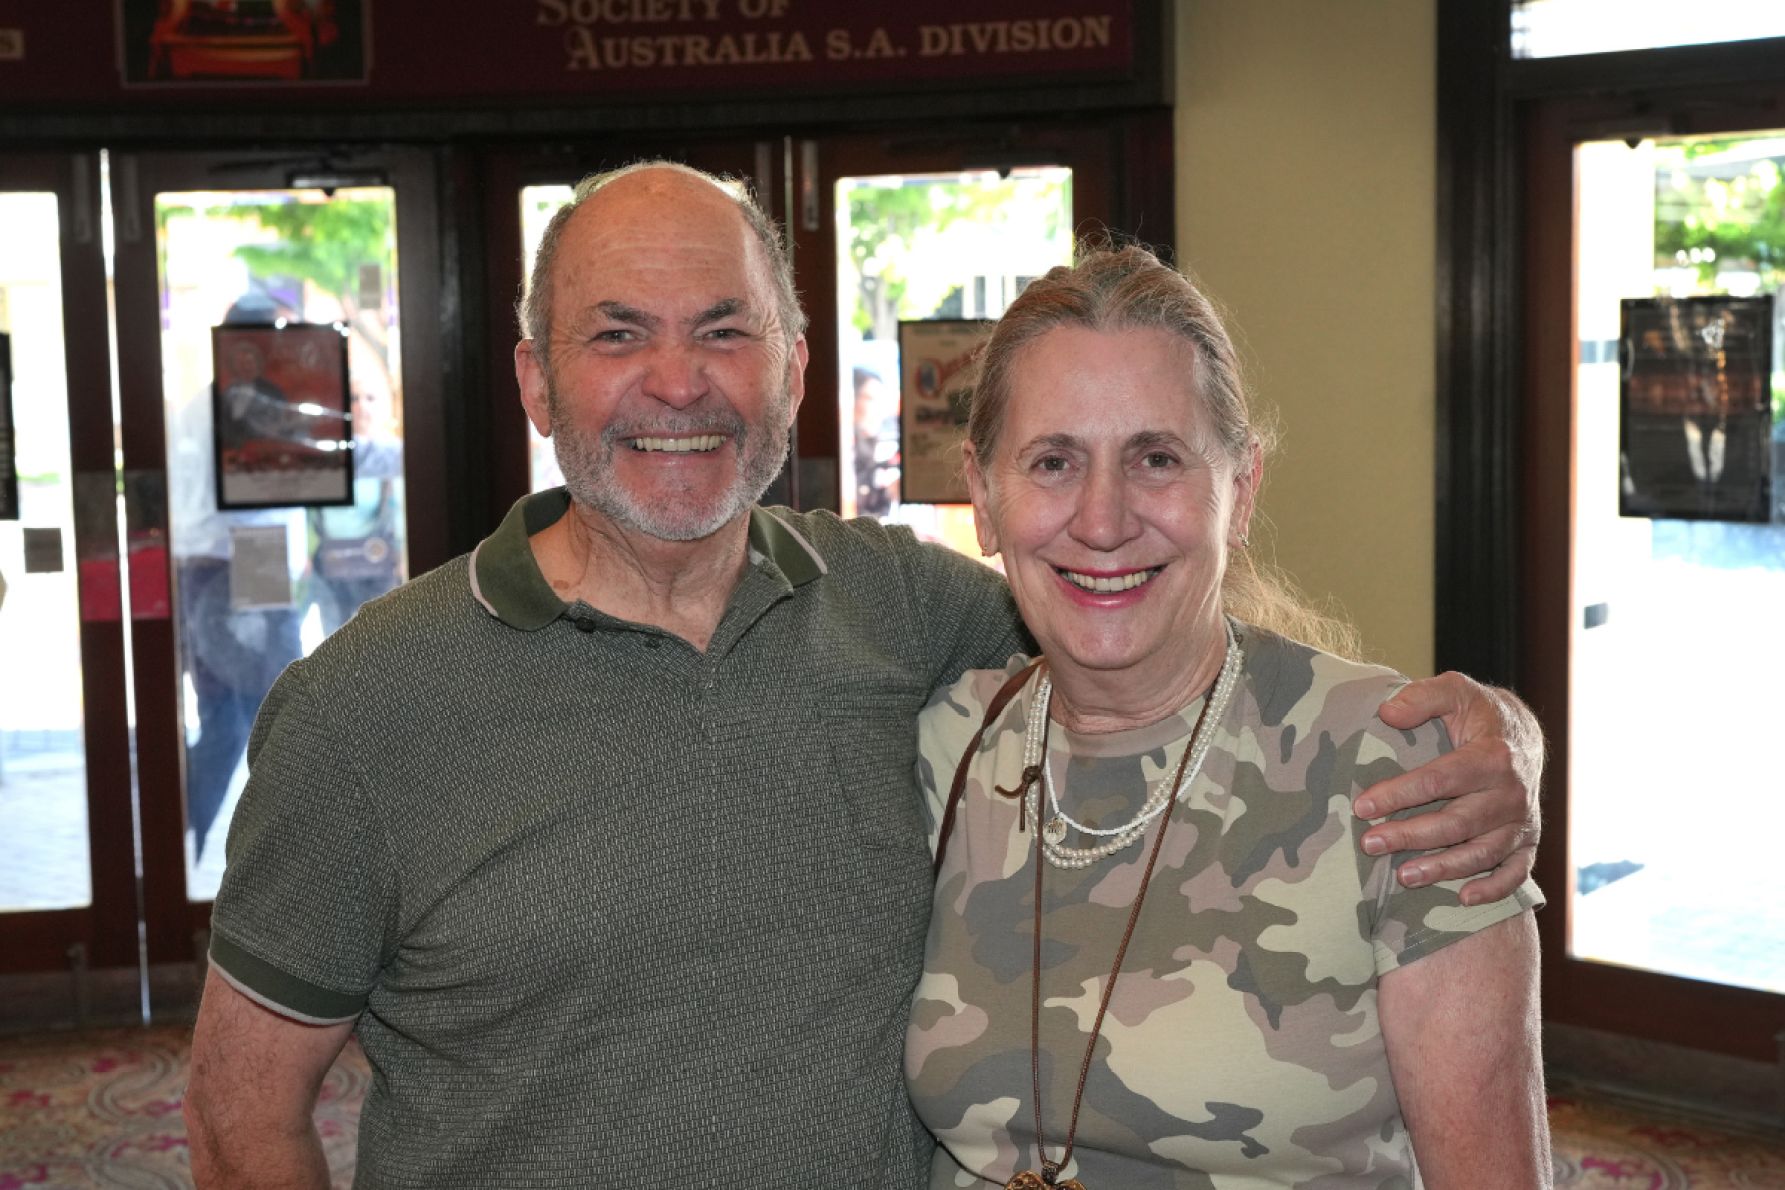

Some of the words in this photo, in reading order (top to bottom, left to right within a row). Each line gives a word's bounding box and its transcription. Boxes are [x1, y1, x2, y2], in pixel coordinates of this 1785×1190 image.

[565, 26, 814, 70] AUSTRALIA
[825, 27, 907, 60] S.A.
[919, 15, 1112, 56] DIVISION
